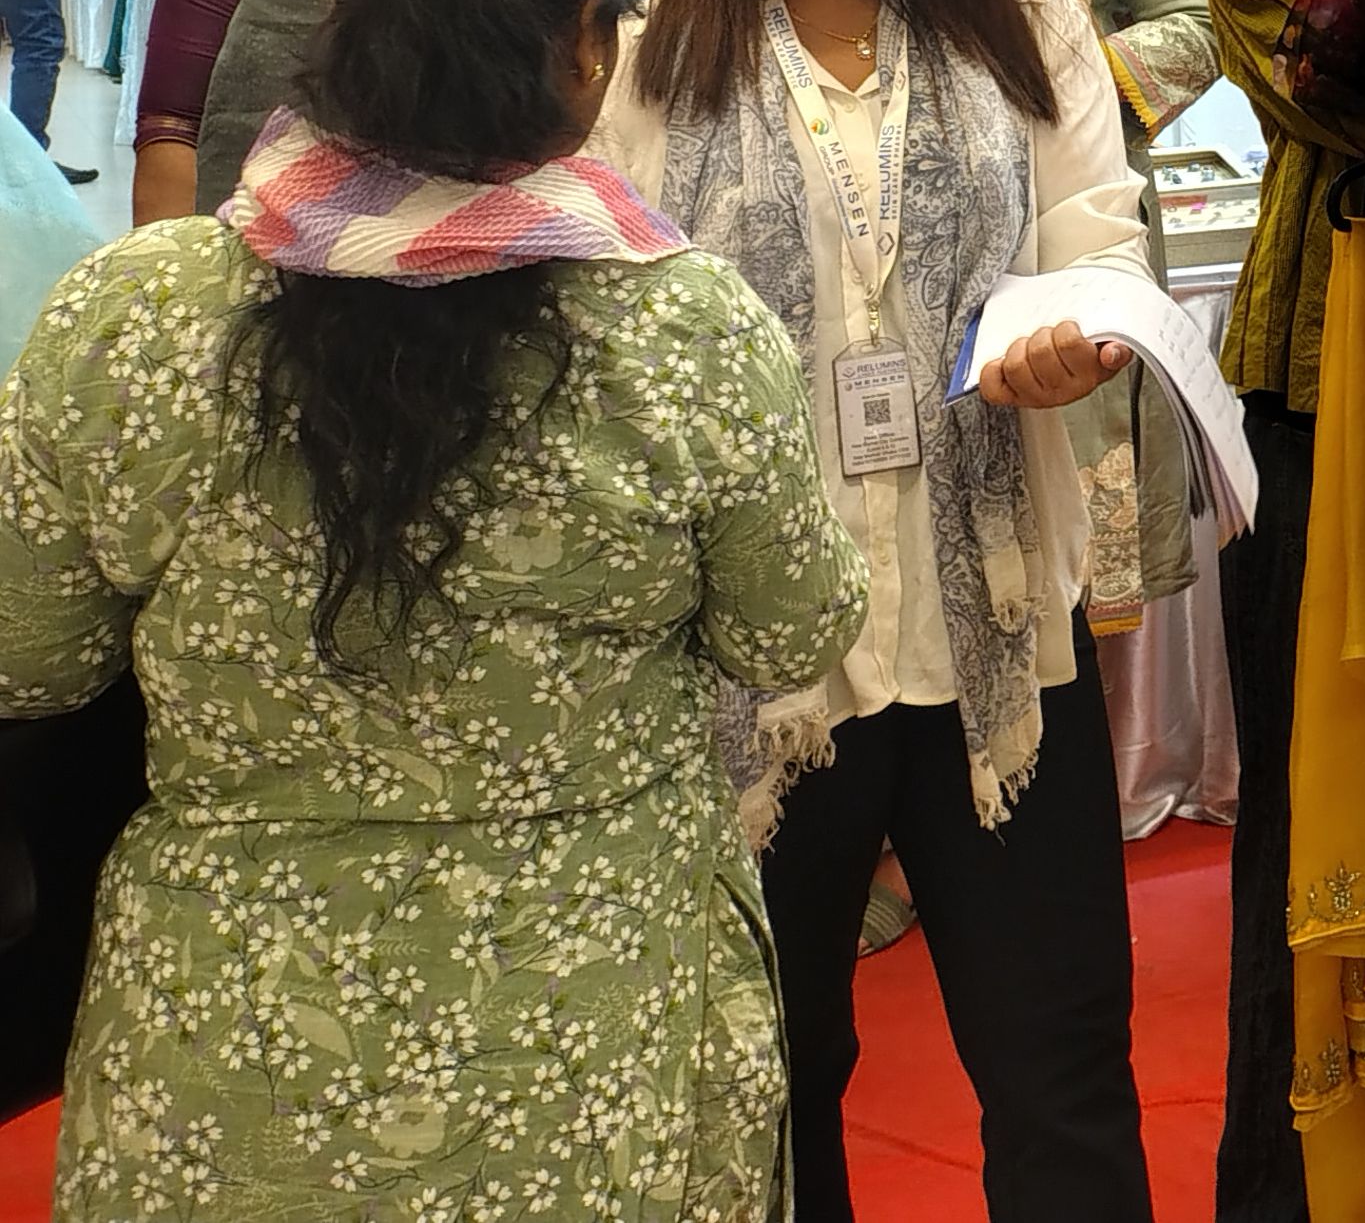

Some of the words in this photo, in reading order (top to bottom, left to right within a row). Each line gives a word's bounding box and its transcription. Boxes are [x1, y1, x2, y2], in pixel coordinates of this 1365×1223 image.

[768, 5, 813, 90] RELUMINS
[819, 145, 836, 176] GROUP
[828, 141, 870, 239] MENSEN
[879, 124, 896, 221] RELUMINS
